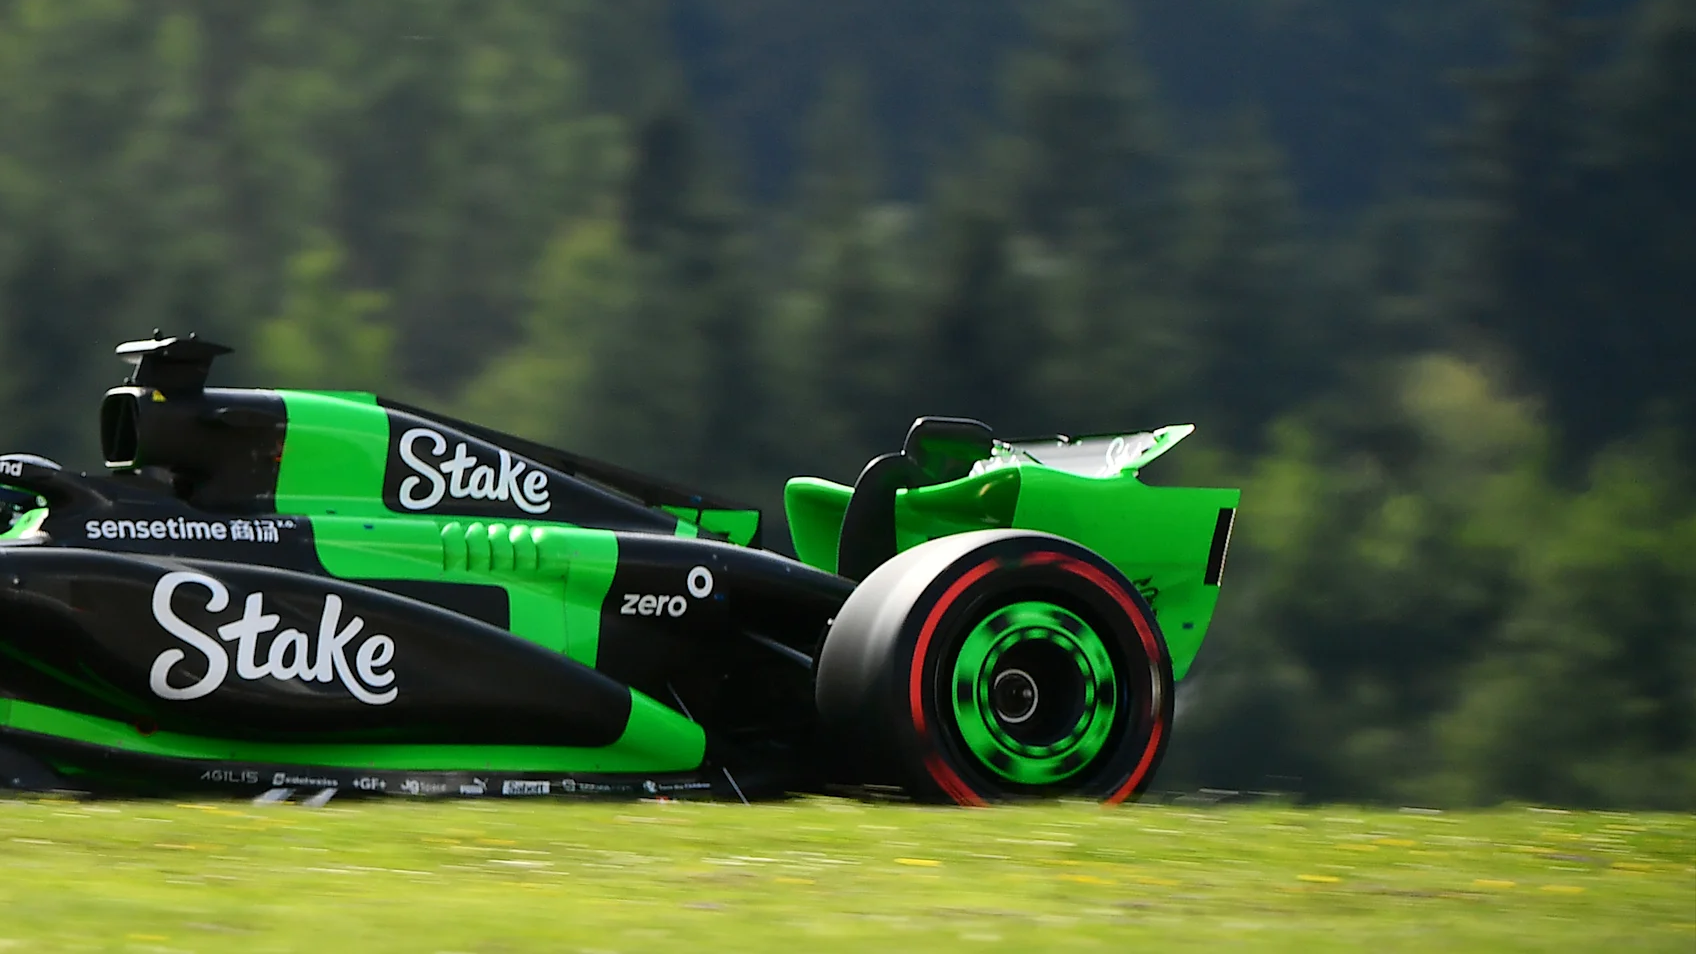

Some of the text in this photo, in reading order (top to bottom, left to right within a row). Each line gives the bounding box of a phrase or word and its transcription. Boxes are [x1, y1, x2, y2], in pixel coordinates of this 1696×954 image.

[399, 427, 551, 513] Stake
[85, 516, 228, 540] sensetime
[620, 593, 688, 618] zero
[149, 570, 398, 705] Stake
